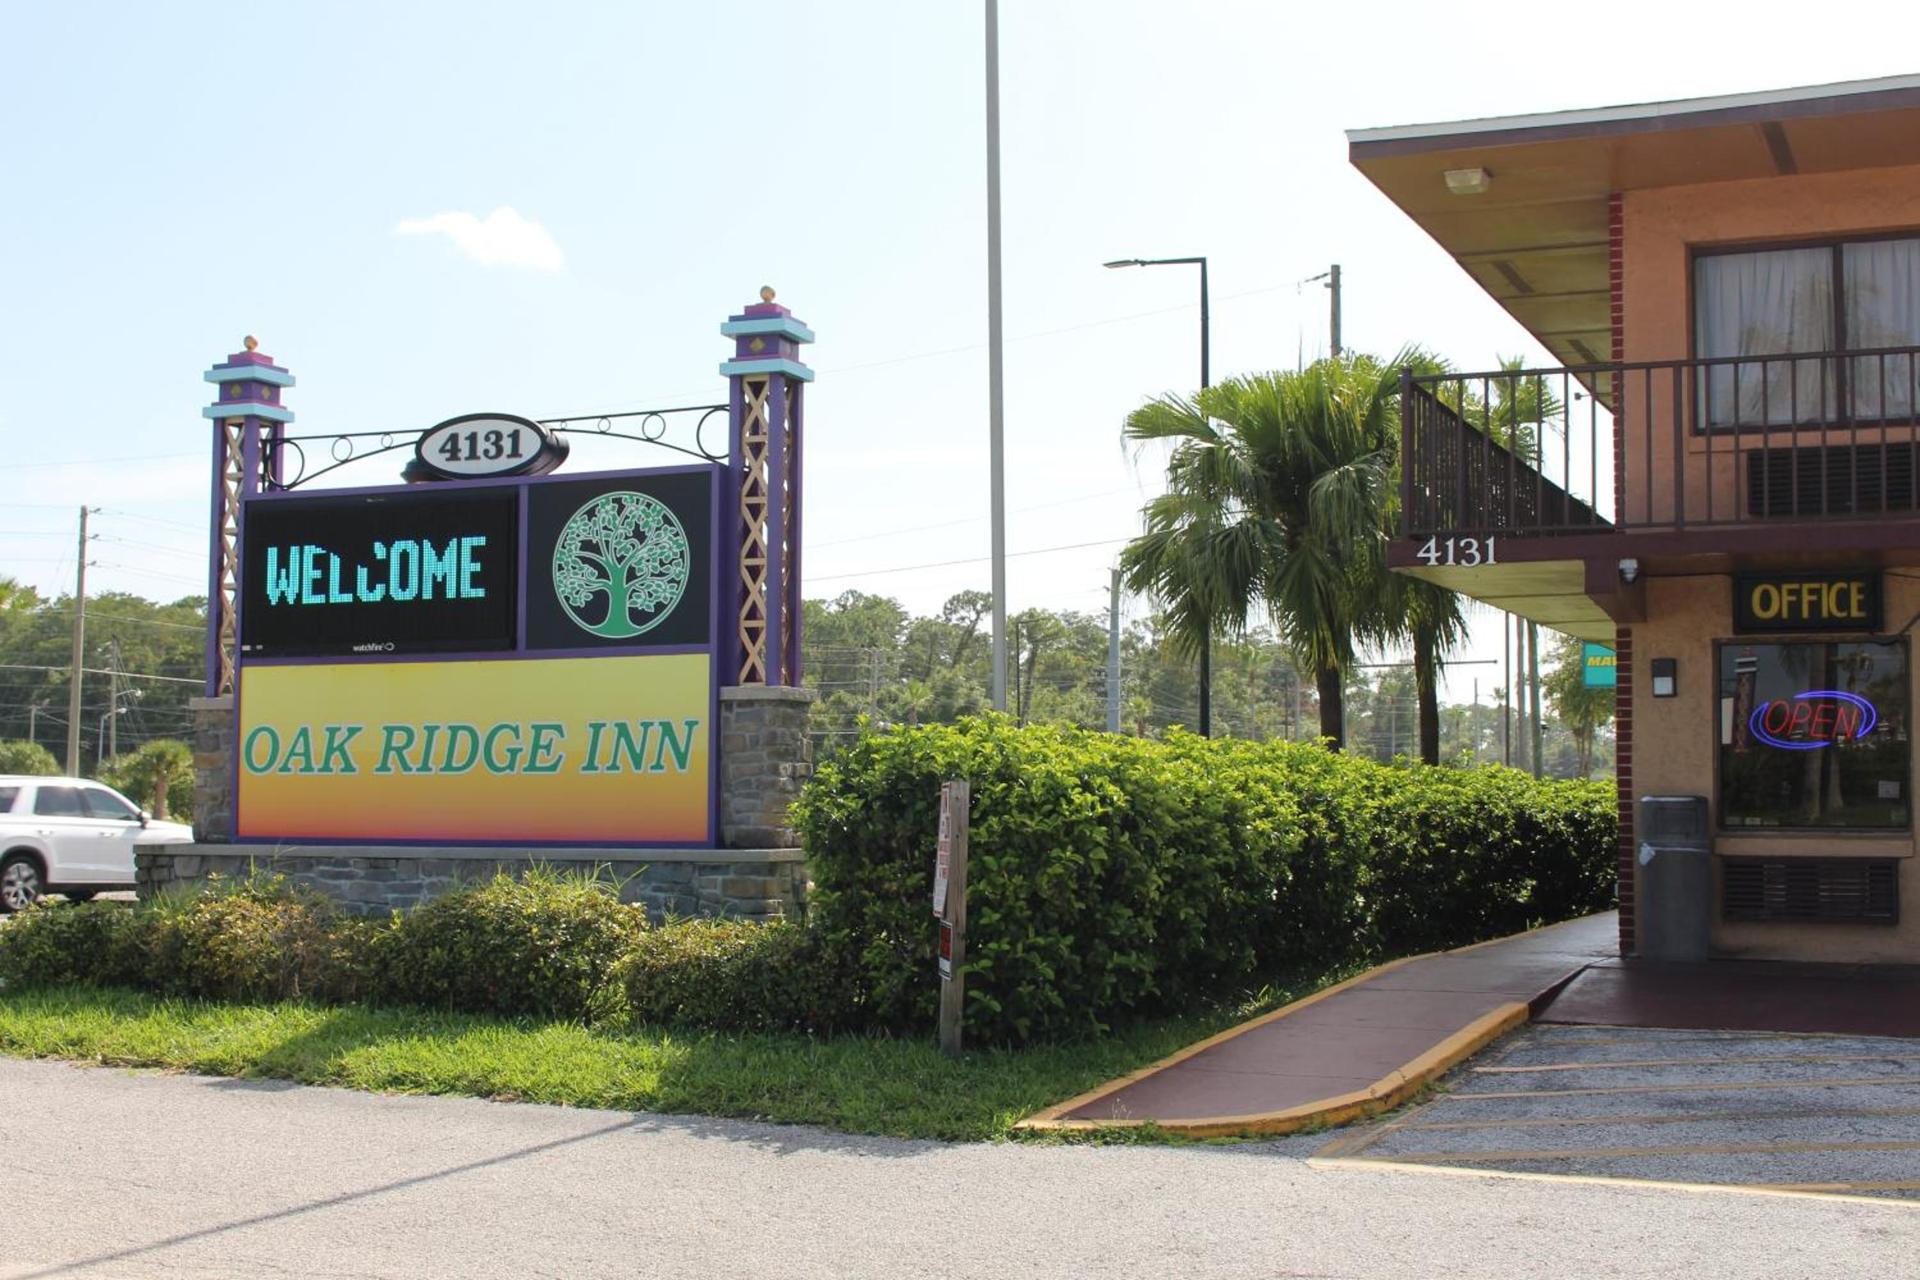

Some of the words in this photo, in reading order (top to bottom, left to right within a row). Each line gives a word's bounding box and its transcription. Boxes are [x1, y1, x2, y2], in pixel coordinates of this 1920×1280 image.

[438, 428, 523, 462] 4131
[1416, 534, 1497, 567] 4131
[266, 535, 487, 606] WELCOME
[1751, 581, 1867, 620] OFFICE
[1765, 700, 1859, 738] OPEN
[243, 724, 363, 774] OAK
[374, 722, 566, 774] RIDGE
[580, 719, 700, 773] INN
